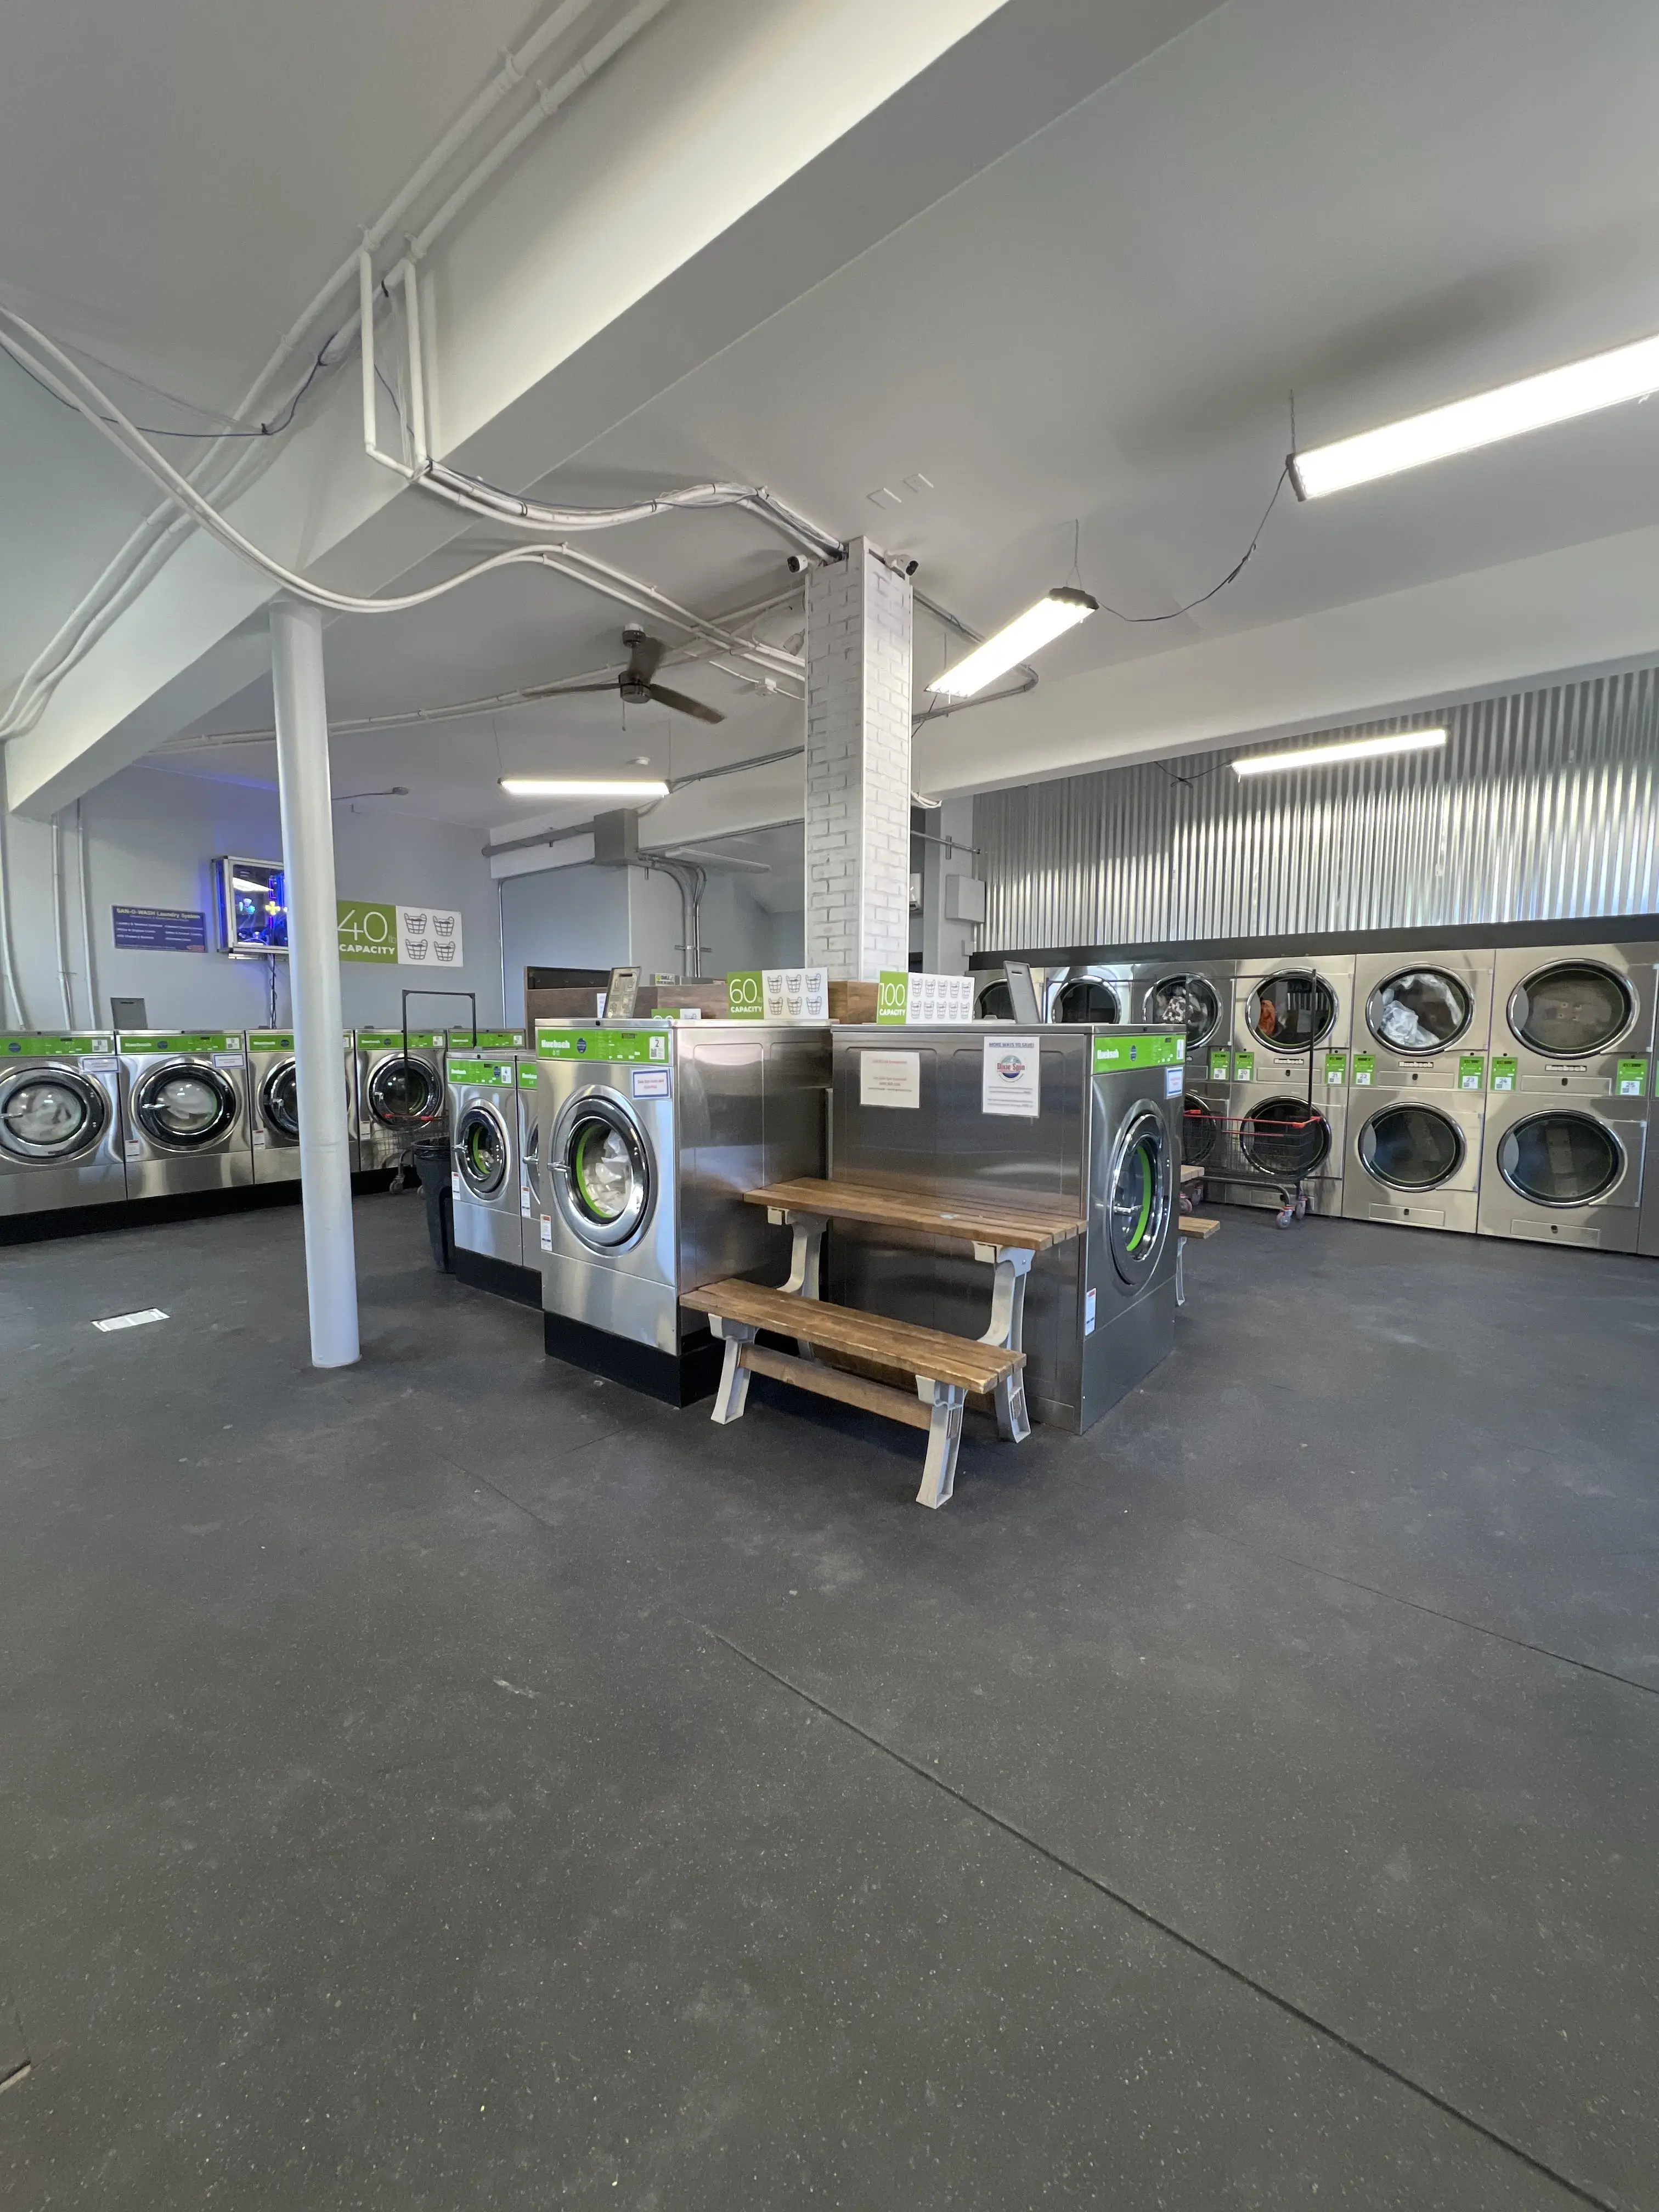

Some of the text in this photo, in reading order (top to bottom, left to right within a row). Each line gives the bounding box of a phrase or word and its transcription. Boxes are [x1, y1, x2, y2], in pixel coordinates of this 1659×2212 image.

[337, 910, 388, 943] 40
[339, 944, 395, 955] CAPACITY
[730, 978, 758, 1004] 60
[879, 983, 905, 1006] 100
[655, 1039, 659, 1047] 2
